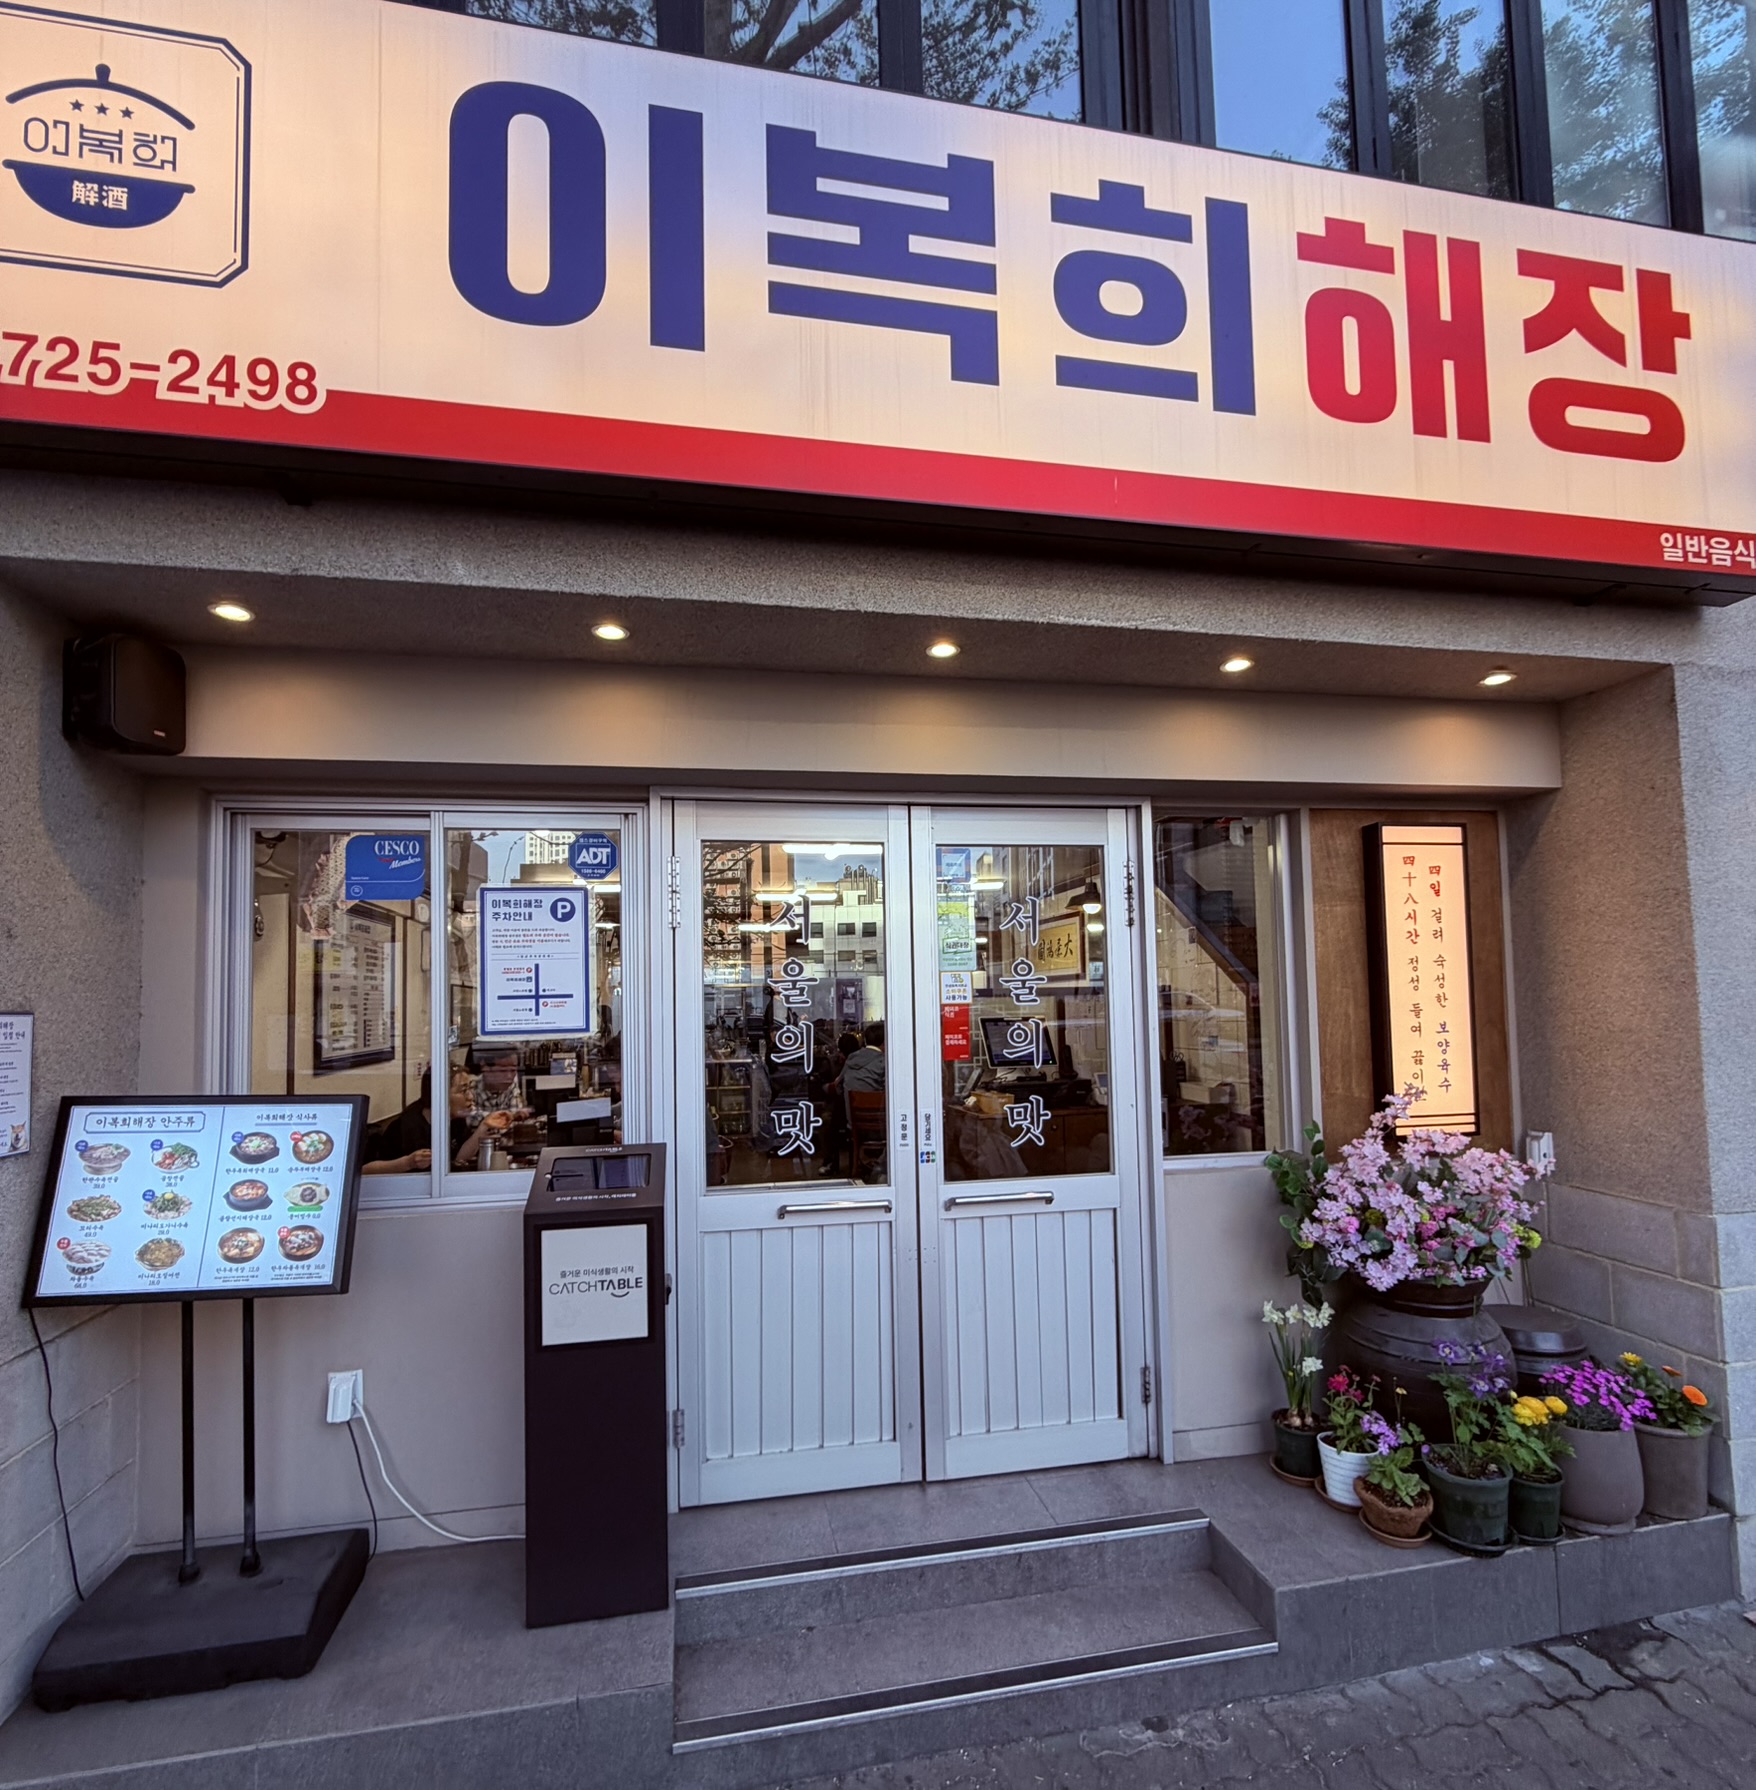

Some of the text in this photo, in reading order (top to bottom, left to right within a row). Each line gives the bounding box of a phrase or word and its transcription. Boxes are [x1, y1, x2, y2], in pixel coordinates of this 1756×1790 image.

[23, 117, 178, 172] 이복희
[71, 180, 129, 211] 解酒
[451, 82, 1690, 462] 이복희해장
[1659, 532, 1756, 569] 일반음식
[374, 840, 420, 855] CESCO
[575, 847, 610, 865] ADT
[491, 899, 543, 909] 이복희해장
[492, 911, 533, 922] 주차안내
[557, 901, 571, 919] P
[1431, 908, 1444, 943] 걸려
[1407, 956, 1420, 992] 정성
[1432, 953, 1448, 1008] 숙성한
[767, 895, 823, 1156] 서울의 맛
[999, 895, 1052, 1148] 서울의 맛
[1409, 1002, 1424, 1038] 들여
[1435, 1021, 1452, 1094] 보양육수
[95, 1116, 195, 1129] 이복희해장 안주류
[295, 1113, 318, 1121] 식사류
[549, 1276, 643, 1295] CATCHTABLE
[560, 1265, 634, 1279] 즐거운 미식생활의 시작
